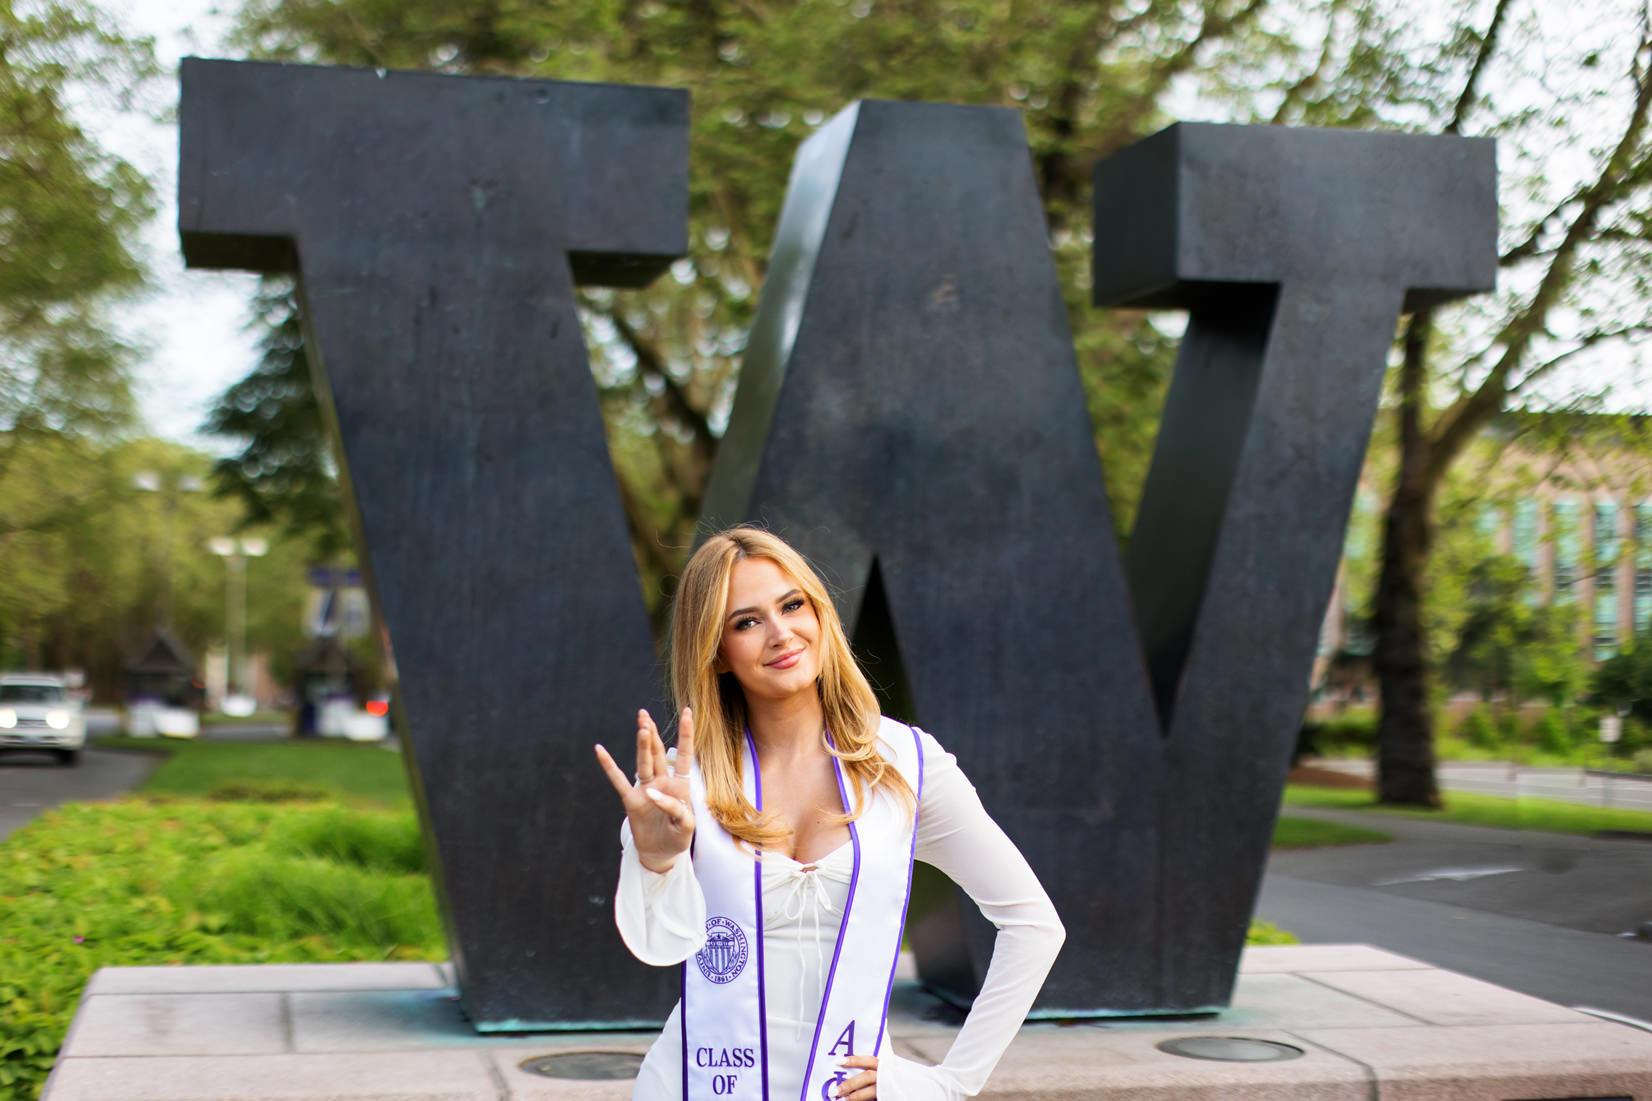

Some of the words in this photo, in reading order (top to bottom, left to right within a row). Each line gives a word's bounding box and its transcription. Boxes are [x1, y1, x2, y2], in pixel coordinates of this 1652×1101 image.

[178, 57, 1498, 1035] W
[725, 919, 747, 977] WASHINGTON
[714, 975, 729, 983] 1861
[696, 1047, 755, 1069] CLASS
[712, 1074, 738, 1096] OF
